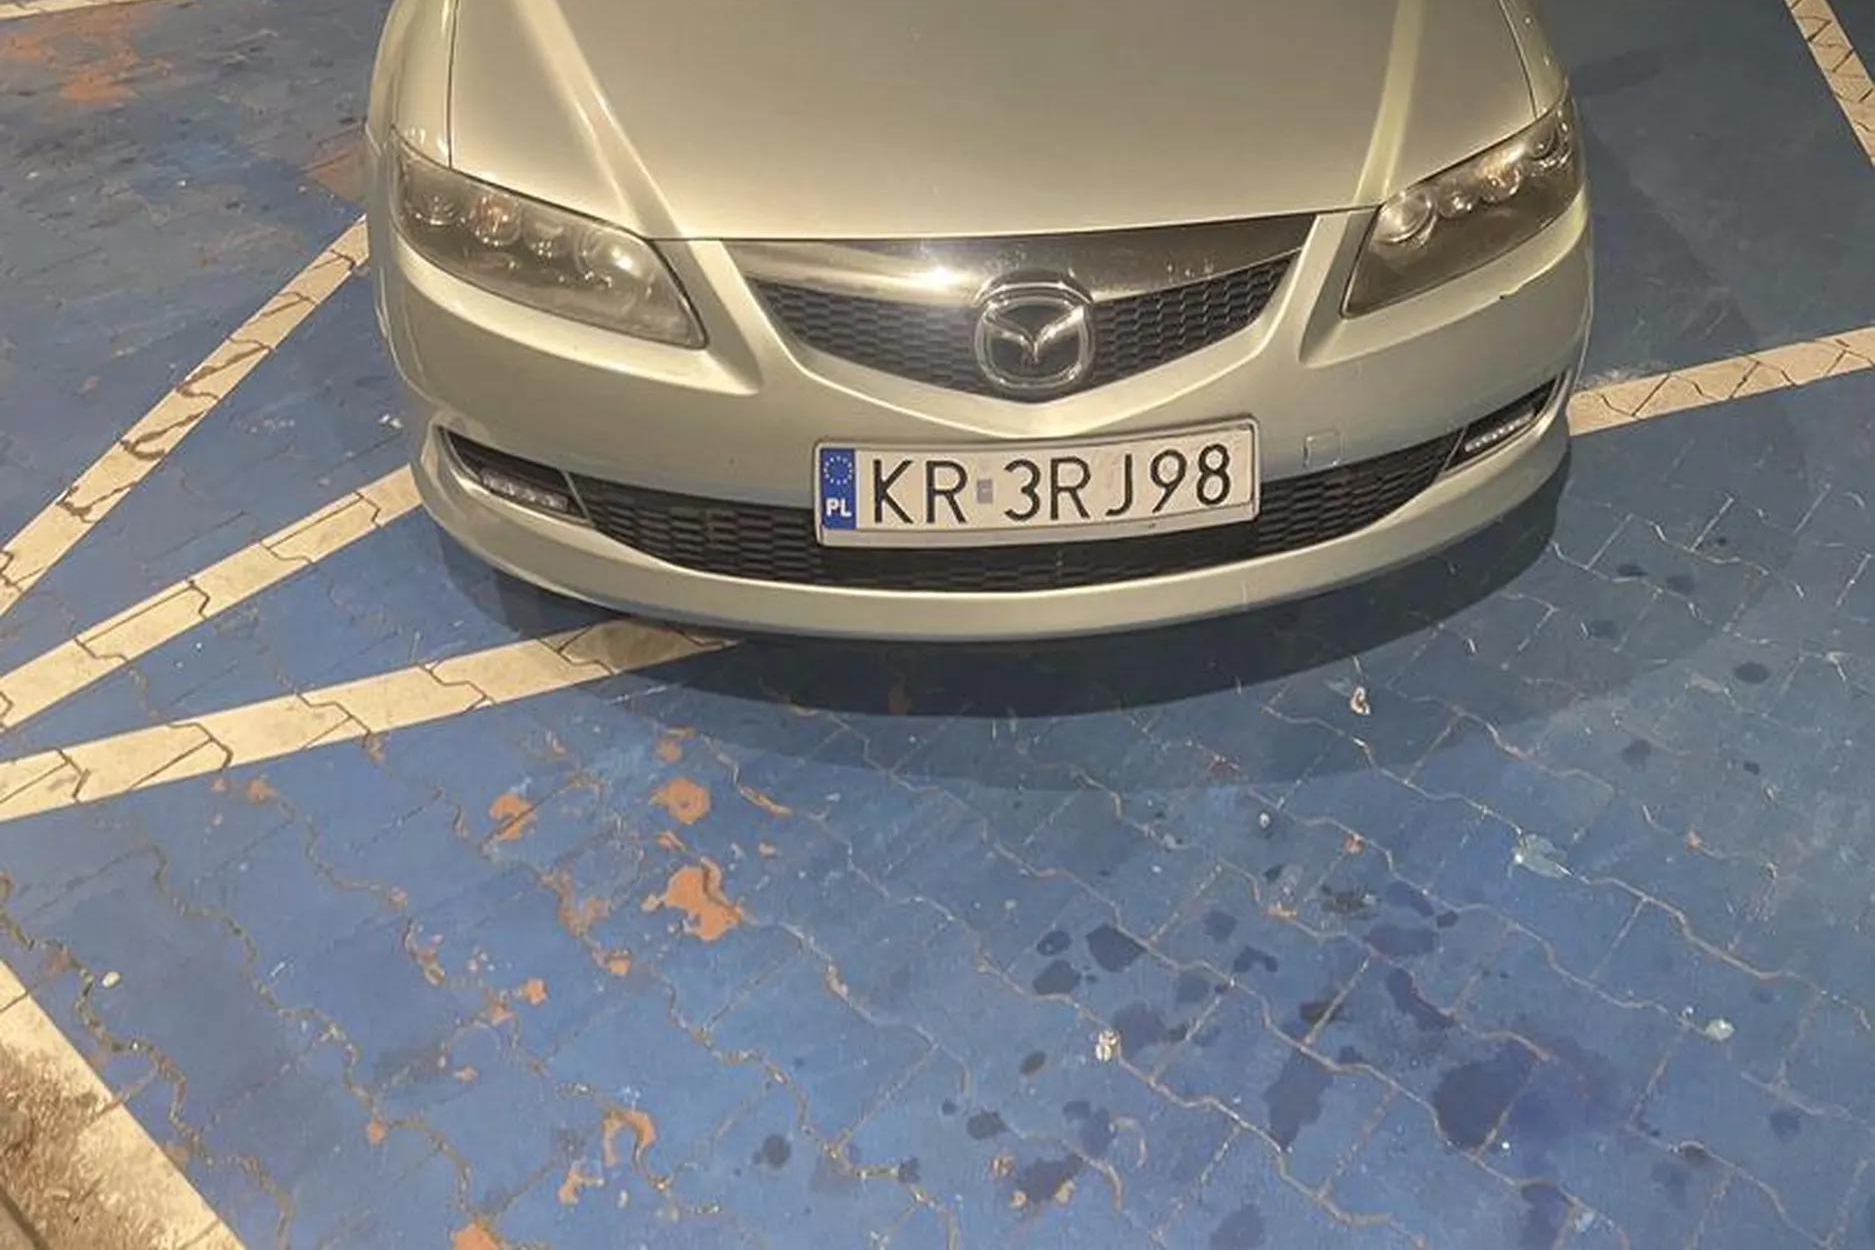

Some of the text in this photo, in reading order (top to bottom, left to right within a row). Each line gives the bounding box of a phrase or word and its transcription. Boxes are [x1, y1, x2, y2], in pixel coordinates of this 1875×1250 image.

[826, 498, 852, 517] PL
[873, 443, 1231, 524] KR 3RJ98
